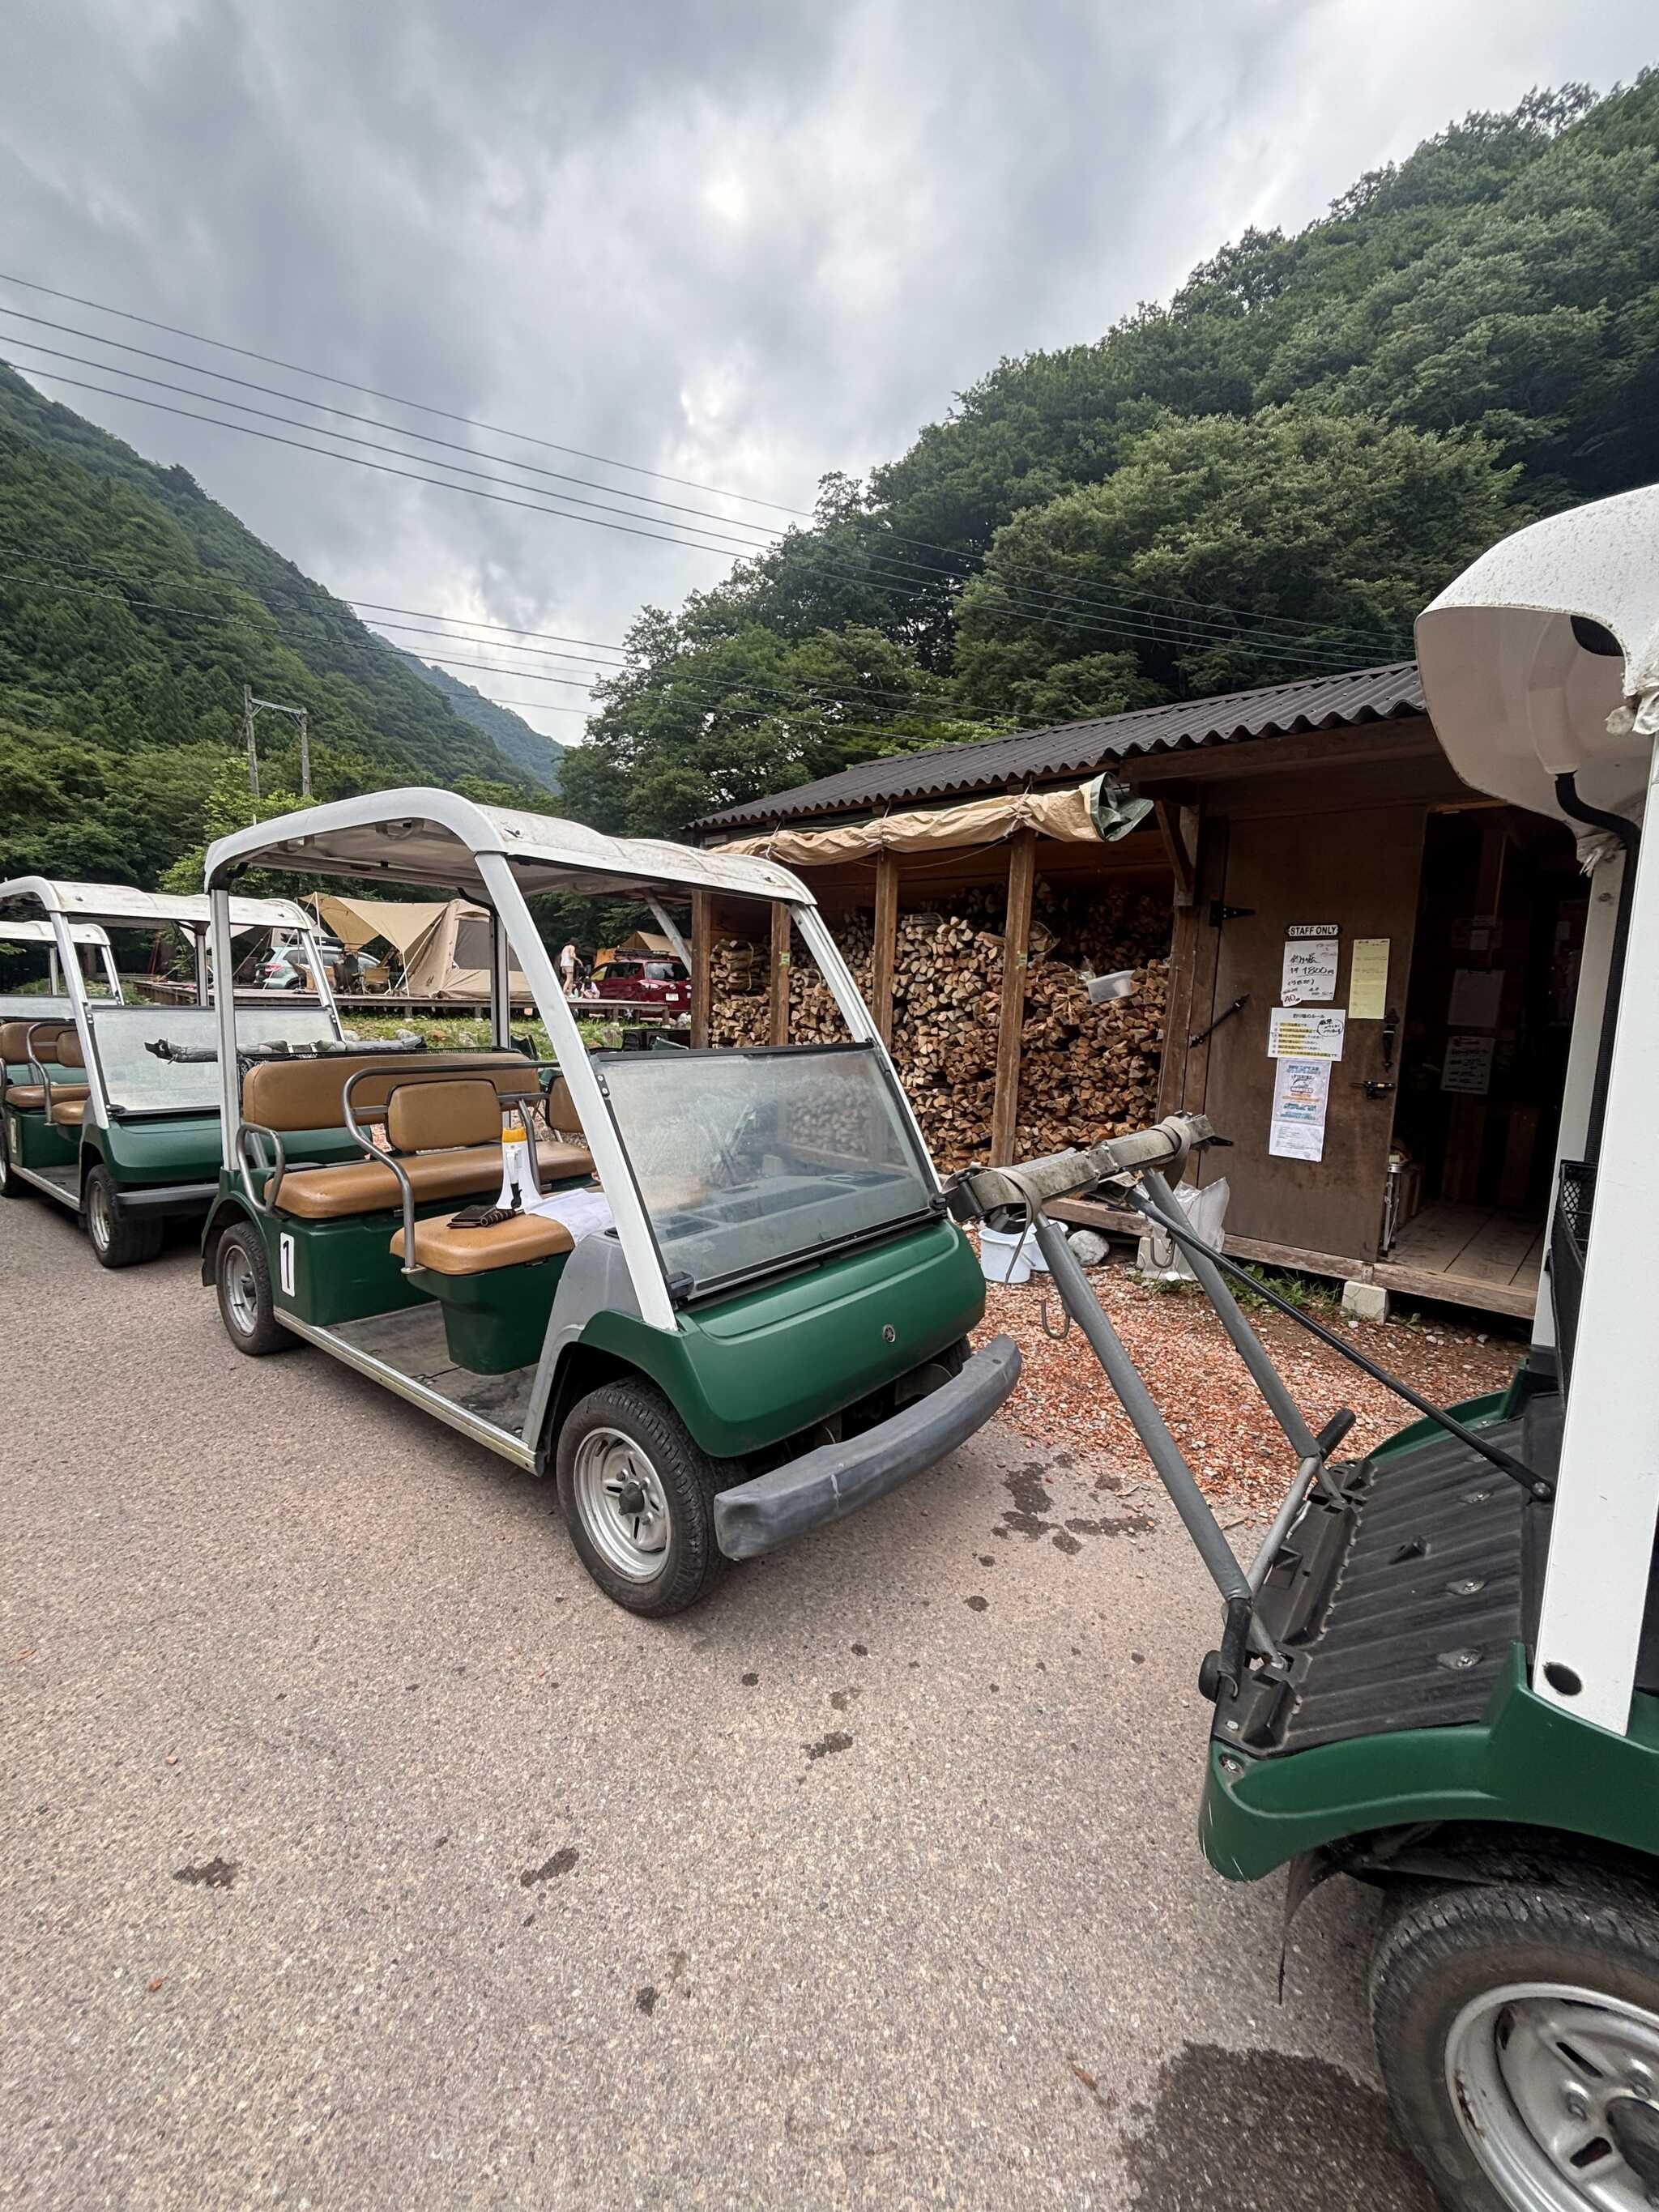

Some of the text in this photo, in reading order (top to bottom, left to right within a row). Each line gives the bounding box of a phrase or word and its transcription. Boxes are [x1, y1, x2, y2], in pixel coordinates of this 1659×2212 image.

[1290, 926, 1337, 936] STAFF ONLY
[283, 1240, 290, 1289] 1
